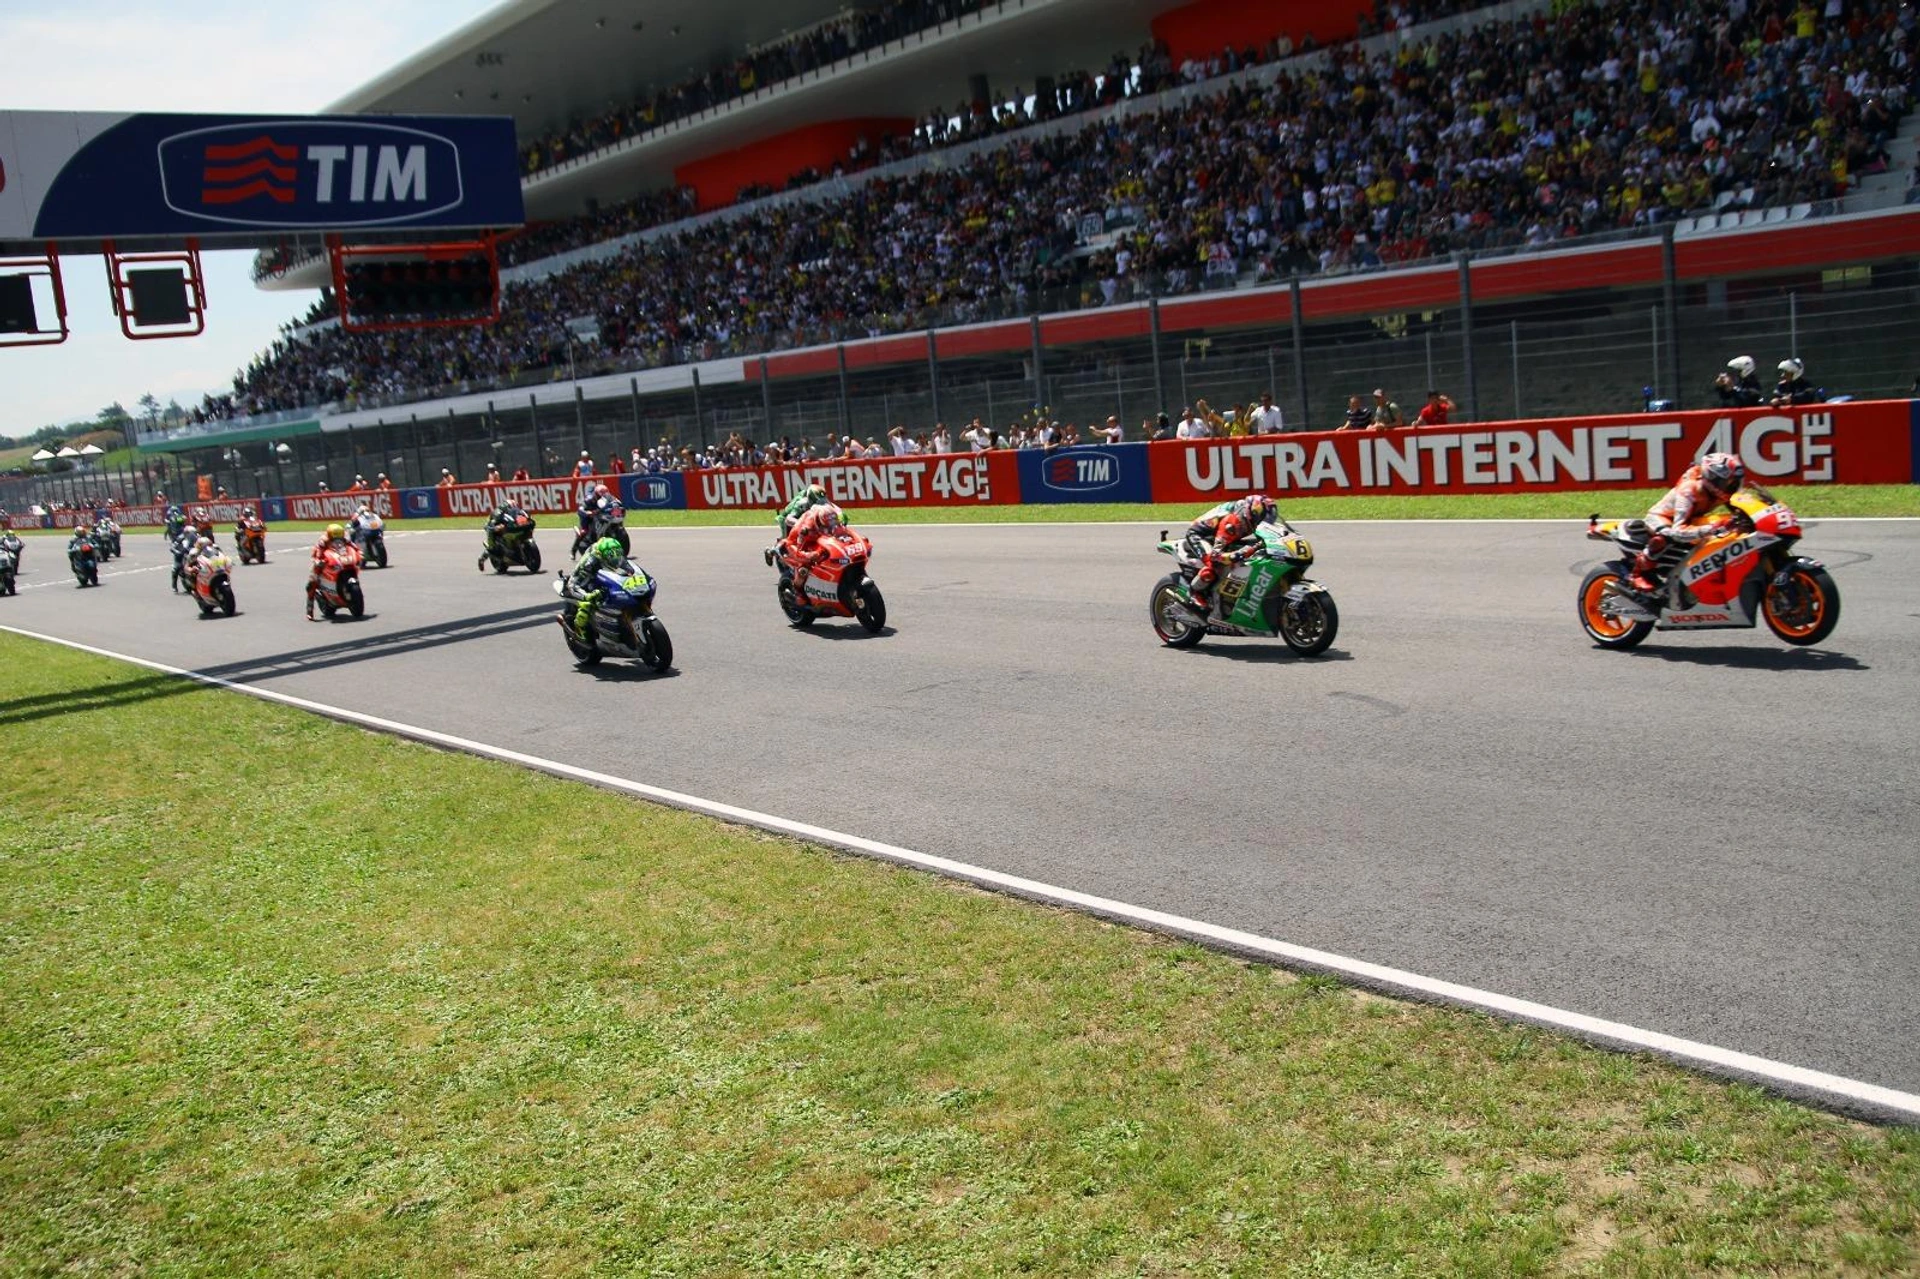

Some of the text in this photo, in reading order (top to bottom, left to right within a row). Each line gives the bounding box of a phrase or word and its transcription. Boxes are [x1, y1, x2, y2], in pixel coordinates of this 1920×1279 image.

[307, 144, 427, 202] TIM
[1185, 412, 1833, 491] ULTRA INTERNET 4G LTE
[702, 456, 990, 506] ULTRA INTERNET 4G LTE
[1076, 459, 1110, 482] TIM
[447, 487, 495, 513] ULTRA
[493, 483, 572, 511] INTERNET
[648, 482, 667, 500] TIM
[292, 497, 323, 519] ULTRA
[1295, 540, 1309, 557] 6
[622, 575, 648, 590] 46
[805, 585, 837, 600] DUCATI
